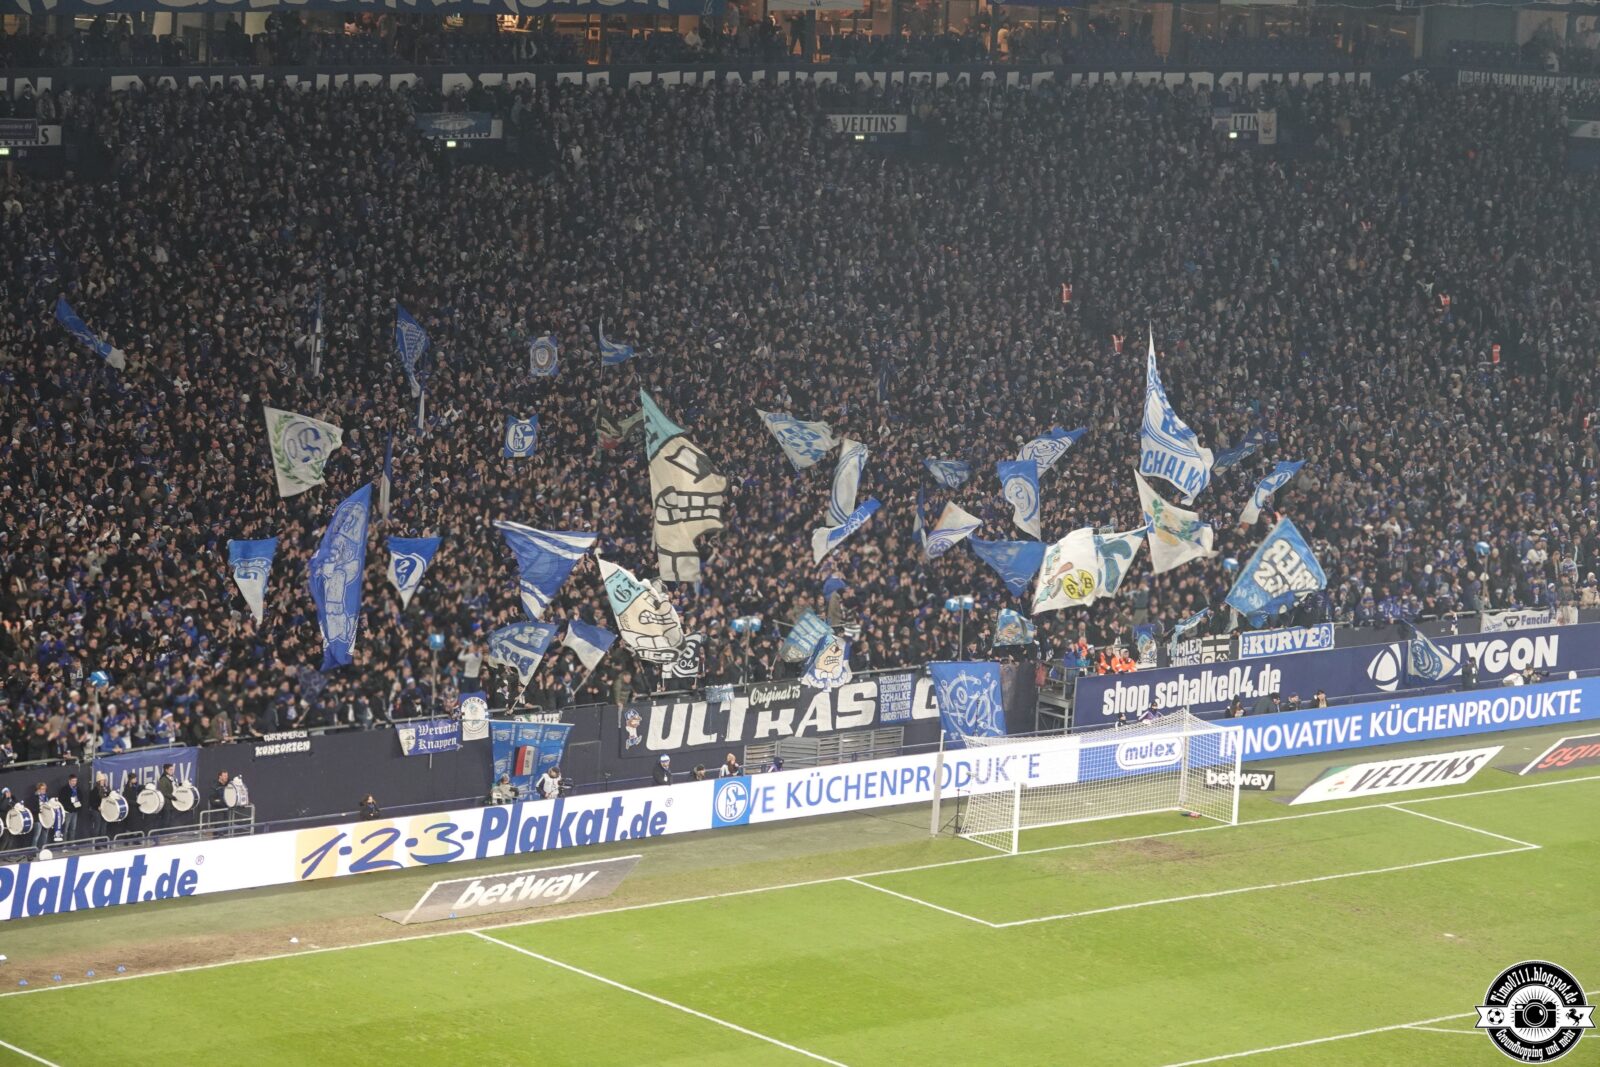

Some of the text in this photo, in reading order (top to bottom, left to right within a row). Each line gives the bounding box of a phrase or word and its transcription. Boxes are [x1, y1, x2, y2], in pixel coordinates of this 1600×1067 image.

[841, 116, 896, 132] VELTINS
[1249, 628, 1320, 655] KURVE
[679, 660, 695, 669] 04
[750, 686, 791, 708] Original
[791, 685, 801, 699] 75
[880, 691, 911, 703] SCHALKE
[1369, 688, 1583, 738] KÜCHENPRODUKTE
[418, 737, 457, 751] Knappen
[1125, 742, 1176, 761] mulex
[786, 753, 1041, 809] KÜCHENPRODUKE
[1349, 754, 1486, 792] VELTINS
[452, 870, 600, 910] betway
